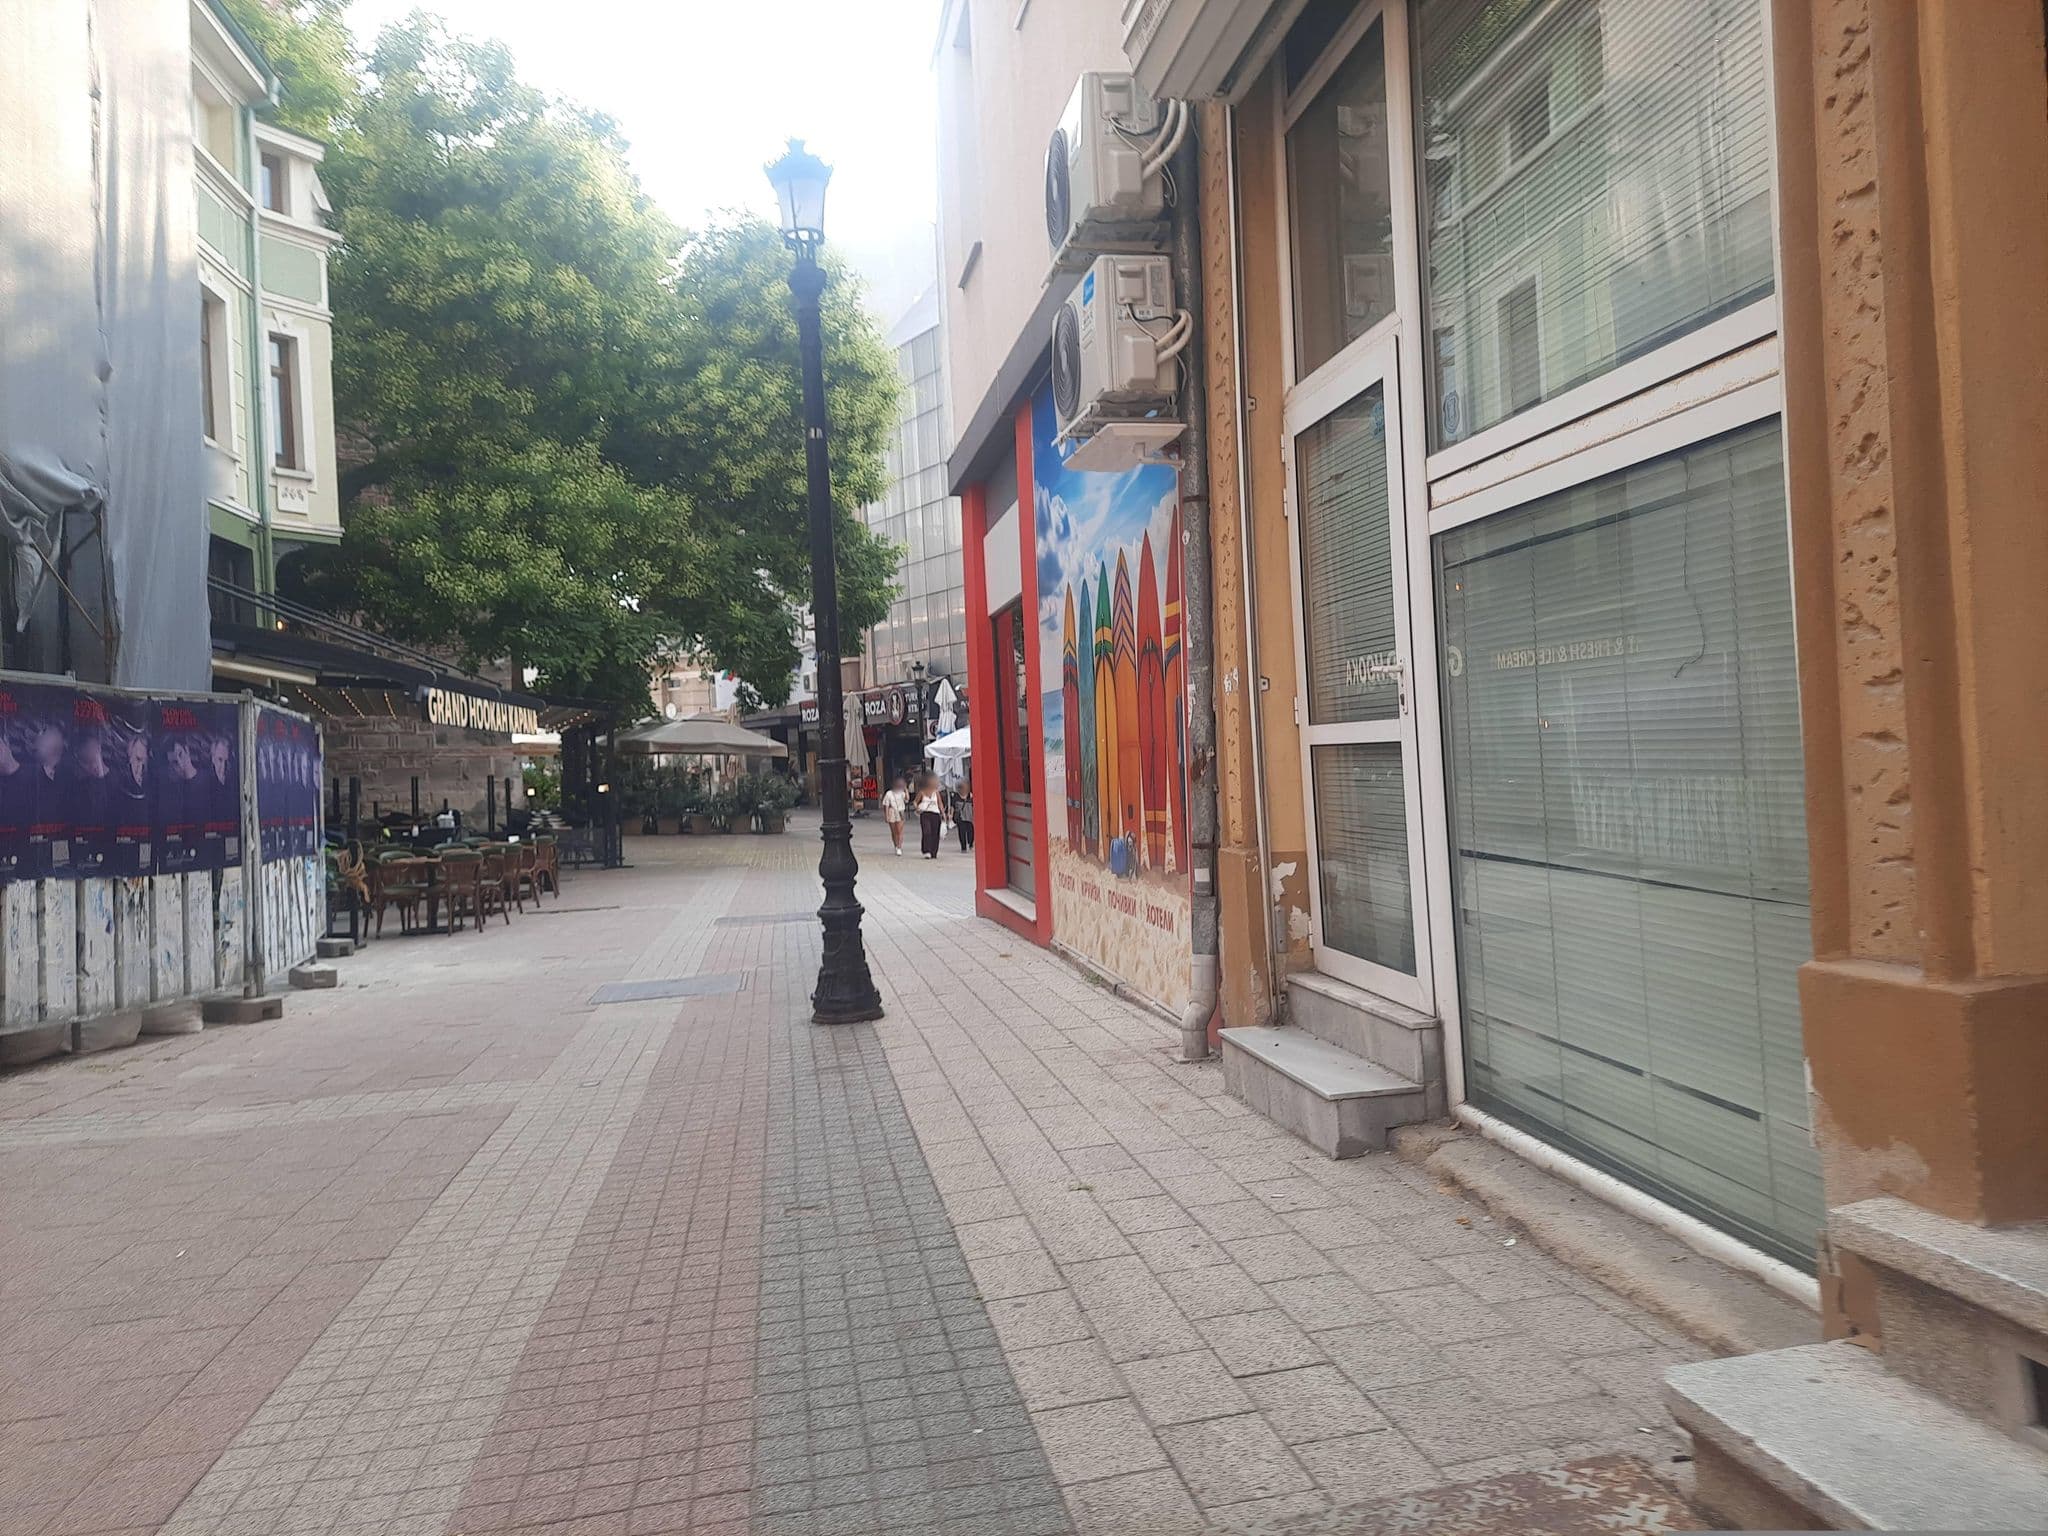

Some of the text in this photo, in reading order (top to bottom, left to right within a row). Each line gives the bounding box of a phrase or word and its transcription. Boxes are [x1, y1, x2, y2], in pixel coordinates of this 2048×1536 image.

[428, 687, 538, 735] GRAND HOOKAH KAPANA
[802, 708, 820, 722] ROZA
[865, 700, 886, 716] ROZA
[1107, 889, 1137, 918] ПОЧИВКИ
[1146, 903, 1174, 933] ХОТЕЛИ
